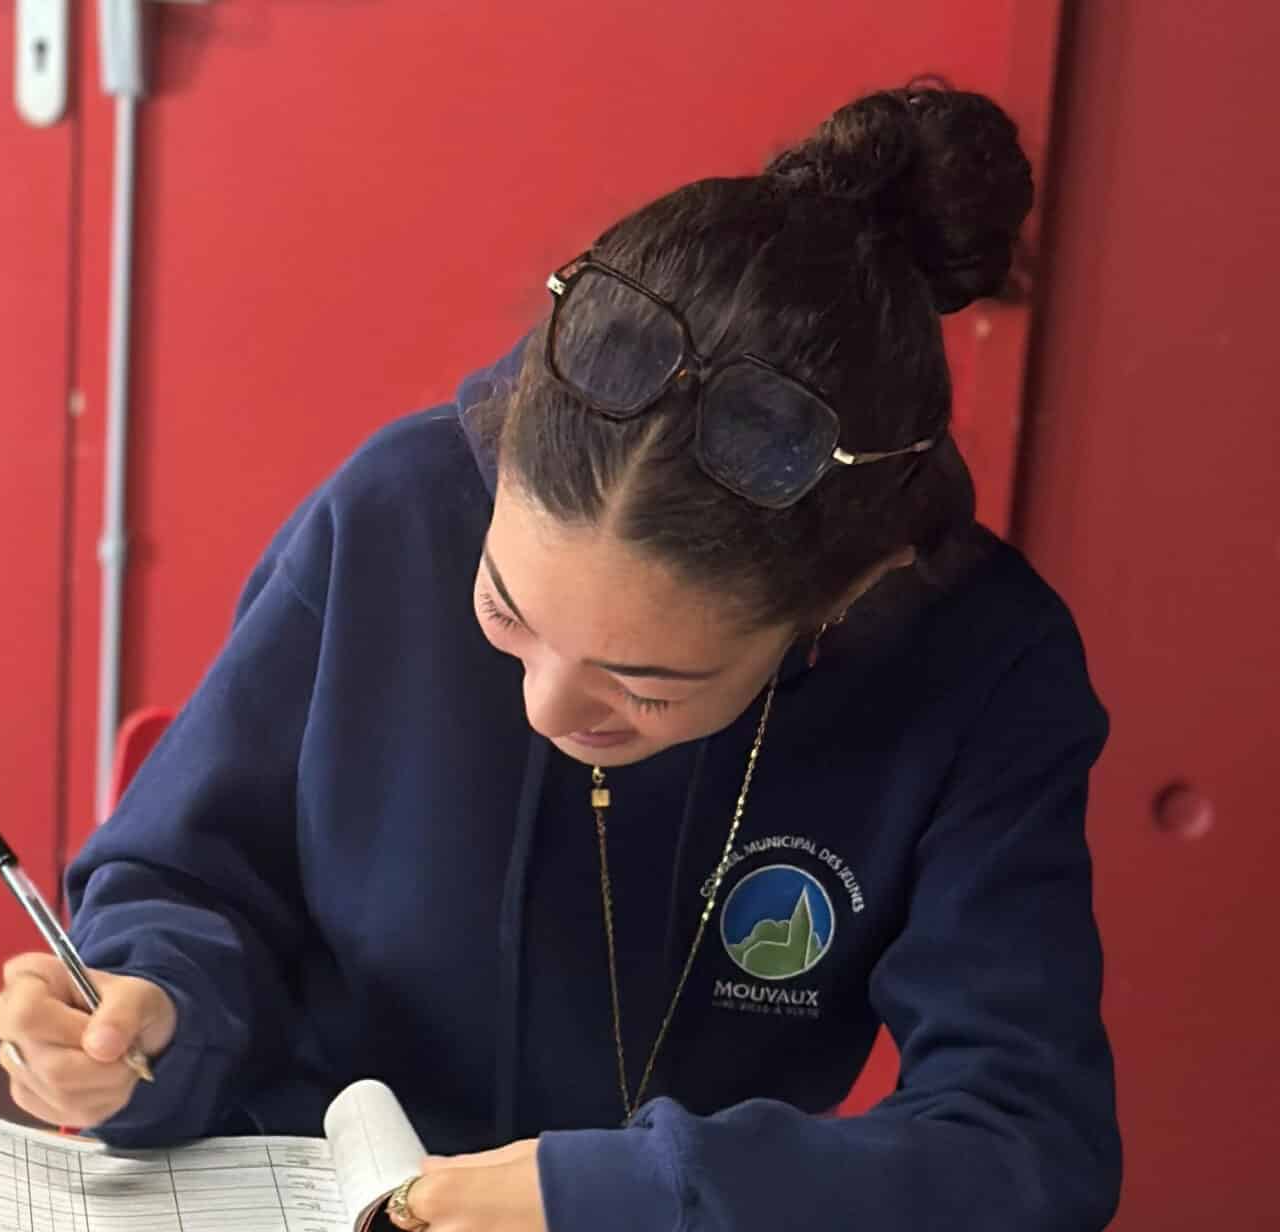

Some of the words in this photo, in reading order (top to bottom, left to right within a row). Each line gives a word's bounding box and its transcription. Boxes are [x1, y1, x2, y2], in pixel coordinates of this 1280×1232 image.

[743, 835, 816, 857] MUNICIPAL
[818, 847, 843, 870] DES
[836, 866, 865, 913] JEUNES
[713, 980, 819, 1007] MOUVAUX
